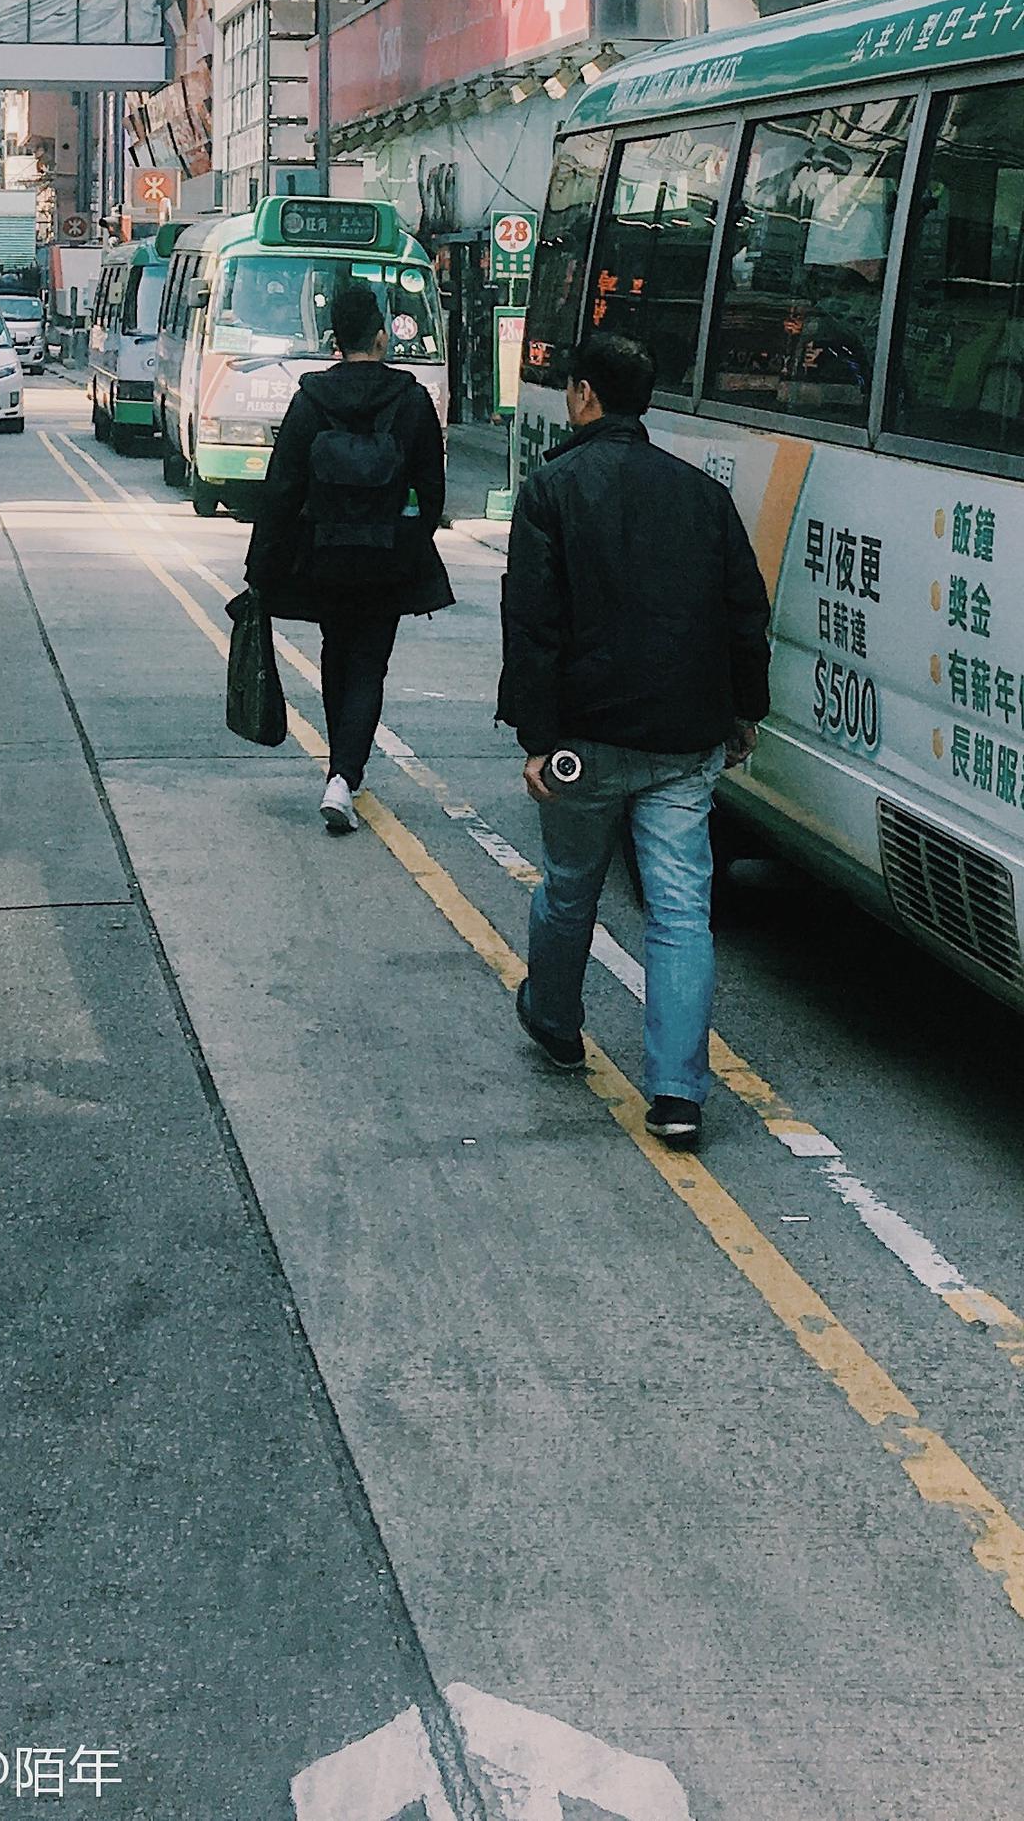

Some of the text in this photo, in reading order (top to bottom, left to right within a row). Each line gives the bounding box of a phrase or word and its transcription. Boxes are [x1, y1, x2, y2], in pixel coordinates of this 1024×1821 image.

[499, 220, 528, 242] 28
[818, 597, 867, 659] 日薪達
[948, 574, 992, 638] 獎金
[813, 649, 877, 747] $500
